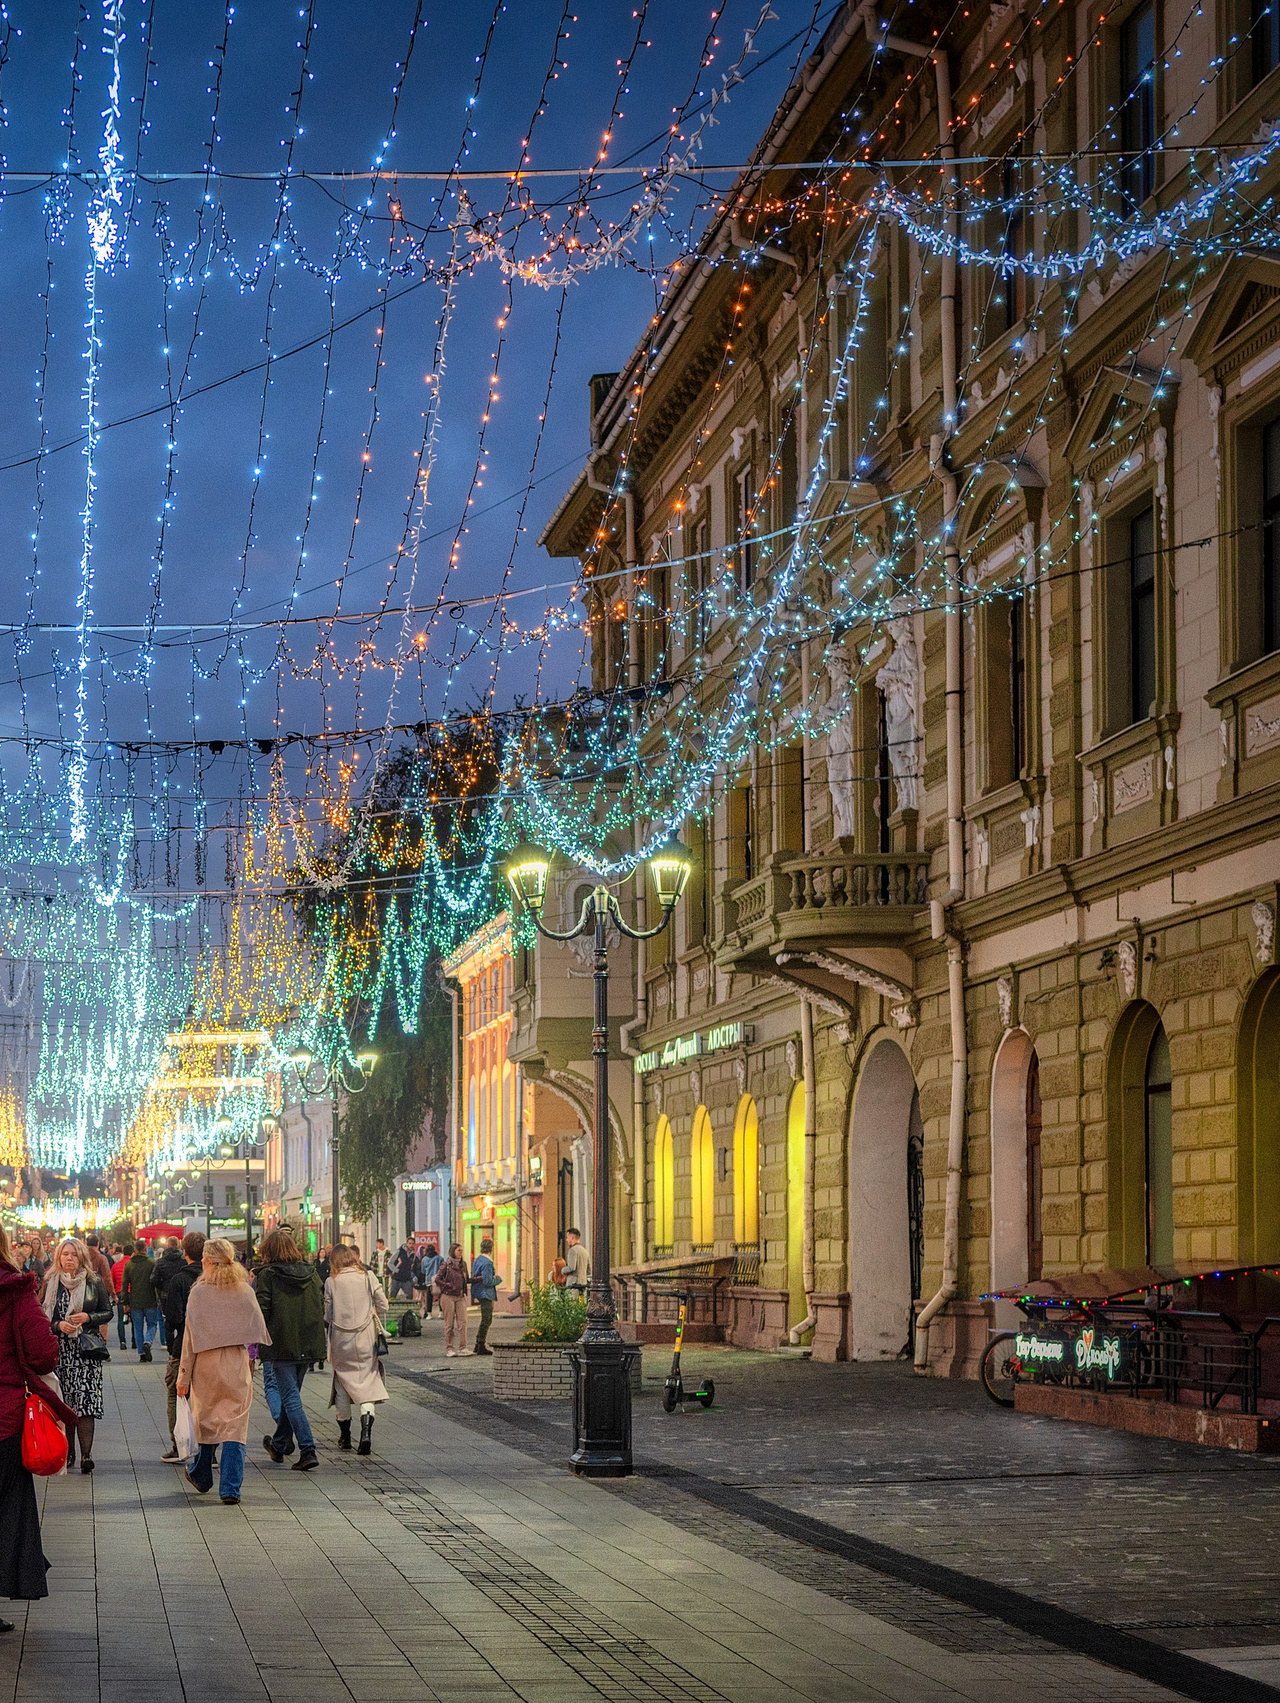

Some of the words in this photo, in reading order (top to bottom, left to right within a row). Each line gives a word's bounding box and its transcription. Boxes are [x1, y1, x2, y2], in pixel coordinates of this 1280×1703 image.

[708, 1022, 741, 1050] ЛЮСТРЫ
[402, 1181, 432, 1191] СУМКИ
[415, 1236, 438, 1245] ВОДА
